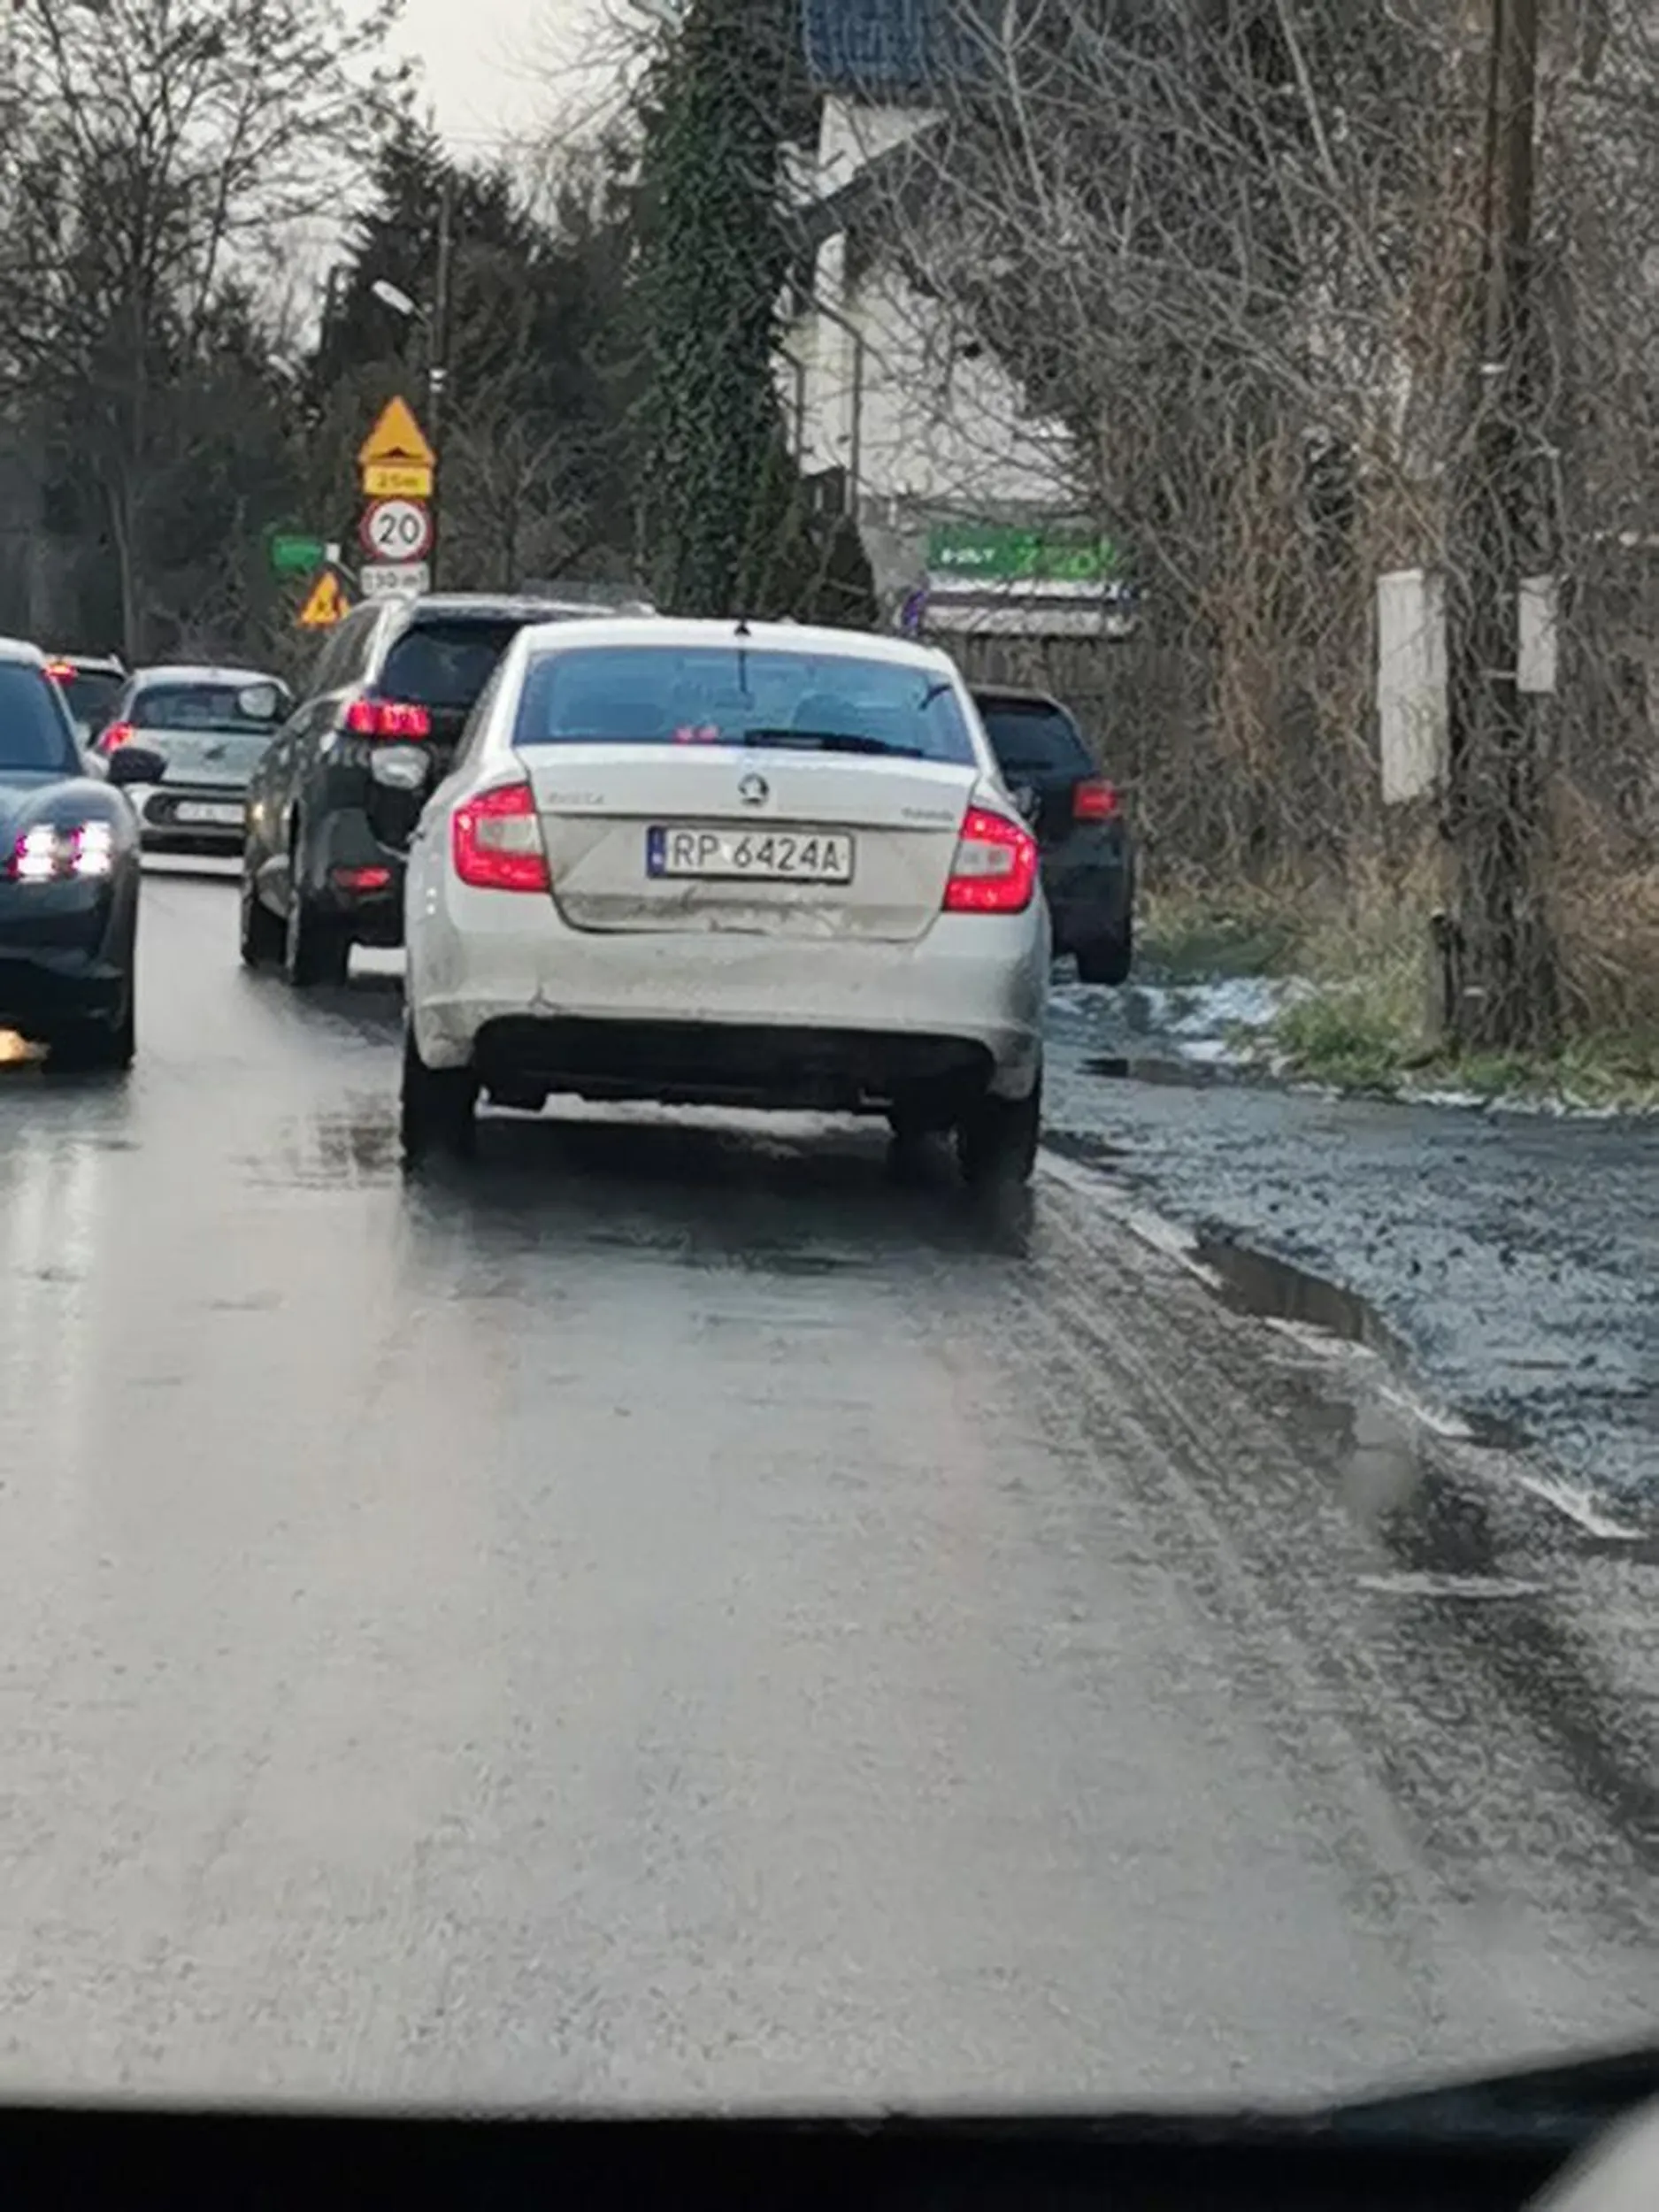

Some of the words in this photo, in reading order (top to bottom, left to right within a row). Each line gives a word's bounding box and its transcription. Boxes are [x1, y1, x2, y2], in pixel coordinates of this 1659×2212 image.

[378, 512, 420, 545] 20
[673, 833, 720, 868] RP
[733, 834, 841, 872] 6424A
